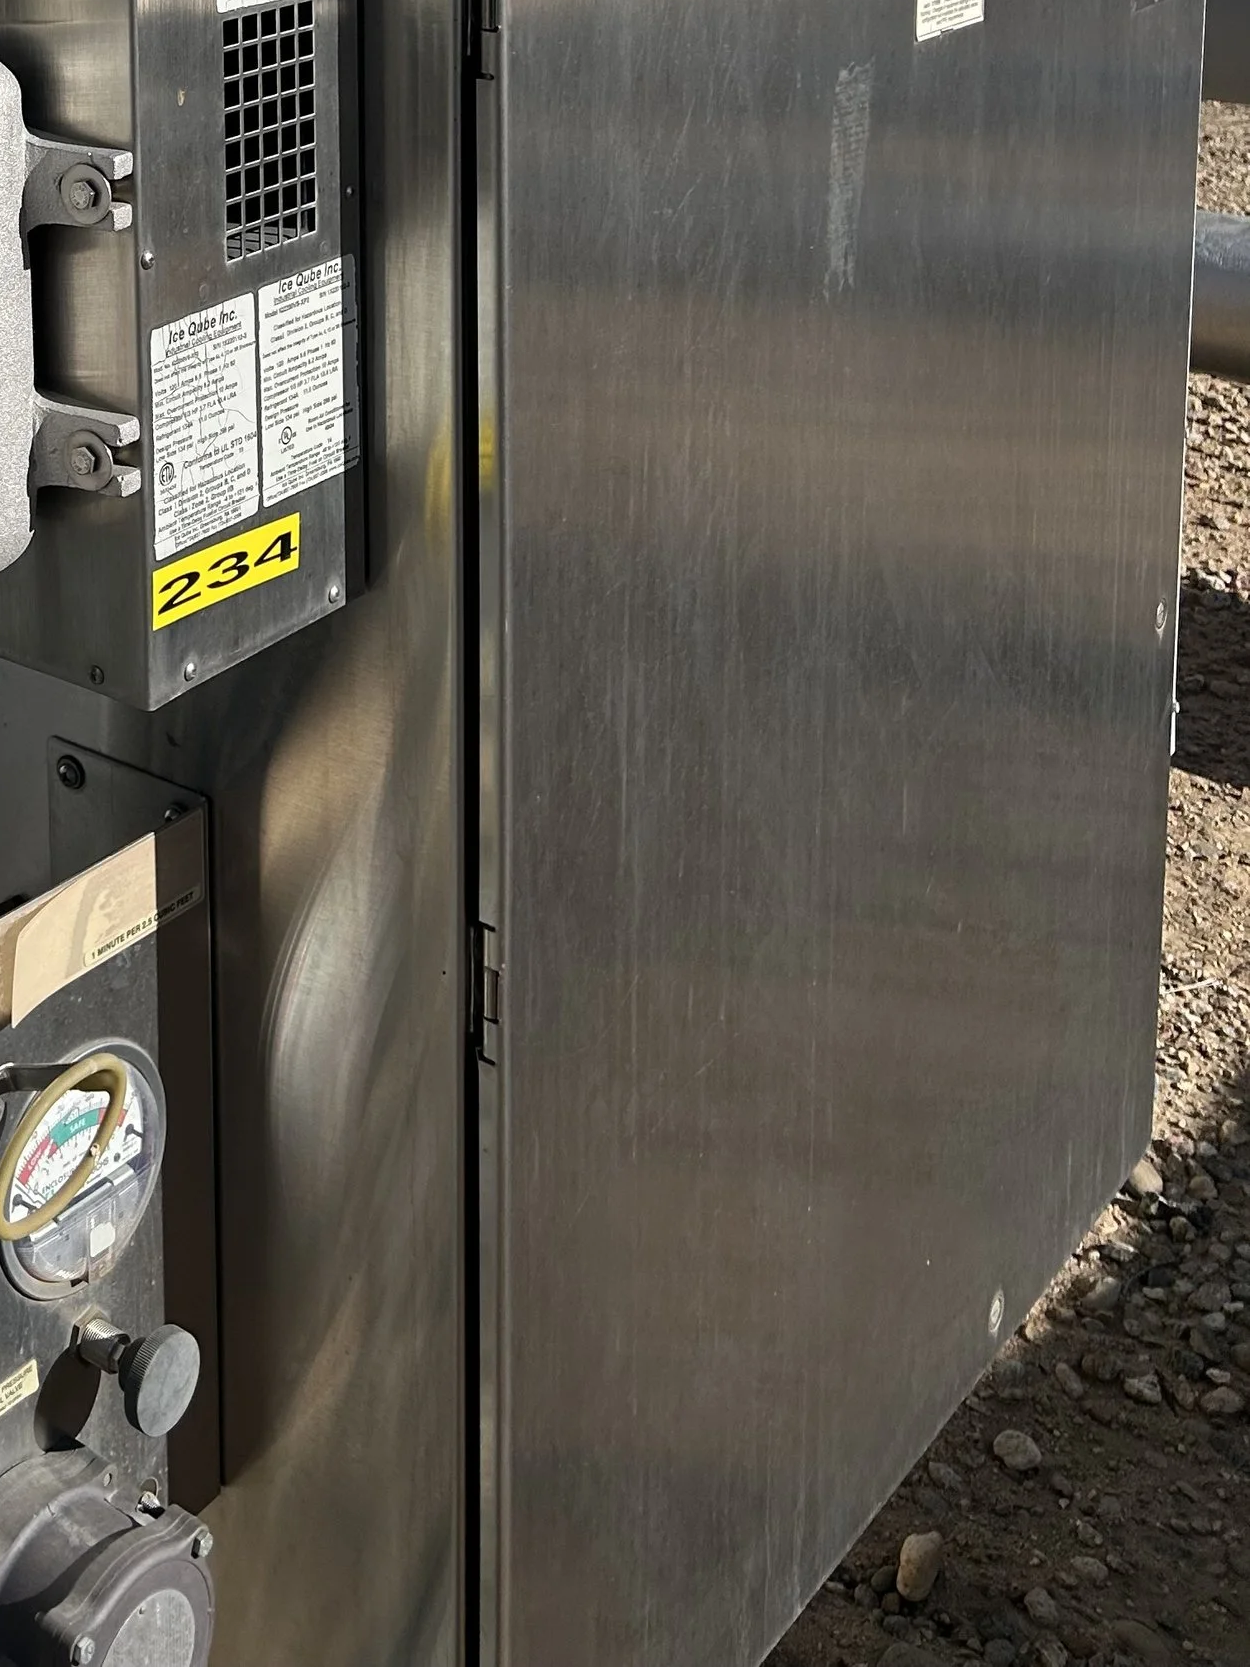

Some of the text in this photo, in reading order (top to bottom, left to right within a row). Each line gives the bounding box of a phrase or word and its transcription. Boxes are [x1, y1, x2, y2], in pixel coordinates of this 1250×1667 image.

[278, 262, 341, 294] Ice Qube Inc.
[273, 289, 297, 306] Industrial
[298, 284, 317, 297] Cooling
[168, 311, 238, 344] Ice Qube Inc.
[191, 334, 212, 346] Cooling
[213, 321, 242, 338] Equipment
[221, 442, 229, 453] UL
[231, 436, 243, 449] STD
[225, 463, 245, 477] Location
[158, 505, 172, 516] Class
[158, 531, 297, 615] 234
[97, 934, 125, 956] MINUTE
[126, 924, 141, 939] PER
[142, 917, 153, 929] 2.5
[176, 891, 194, 908] FEET
[1, 1364, 33, 1394] PRESSURE
[4, 1381, 23, 1400] VALVE
